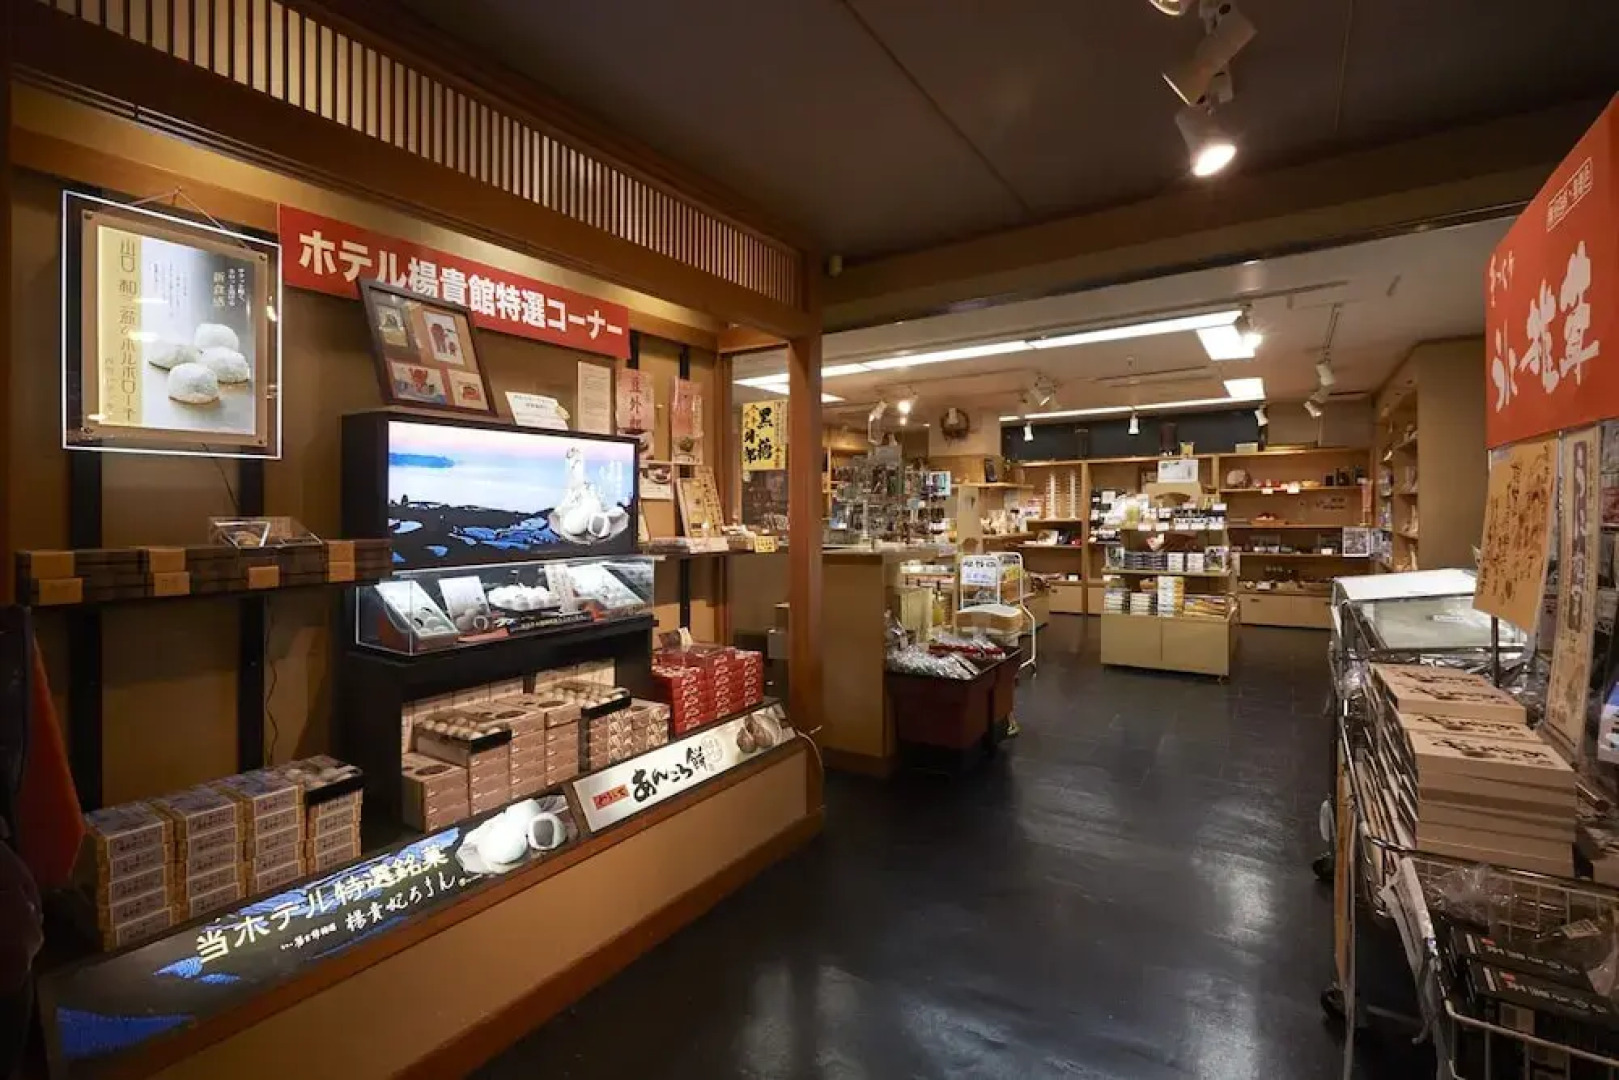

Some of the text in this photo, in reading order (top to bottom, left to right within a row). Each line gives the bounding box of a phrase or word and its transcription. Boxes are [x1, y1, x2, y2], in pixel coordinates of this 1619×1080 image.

[196, 843, 450, 963] 当ホテル特選銘菓
